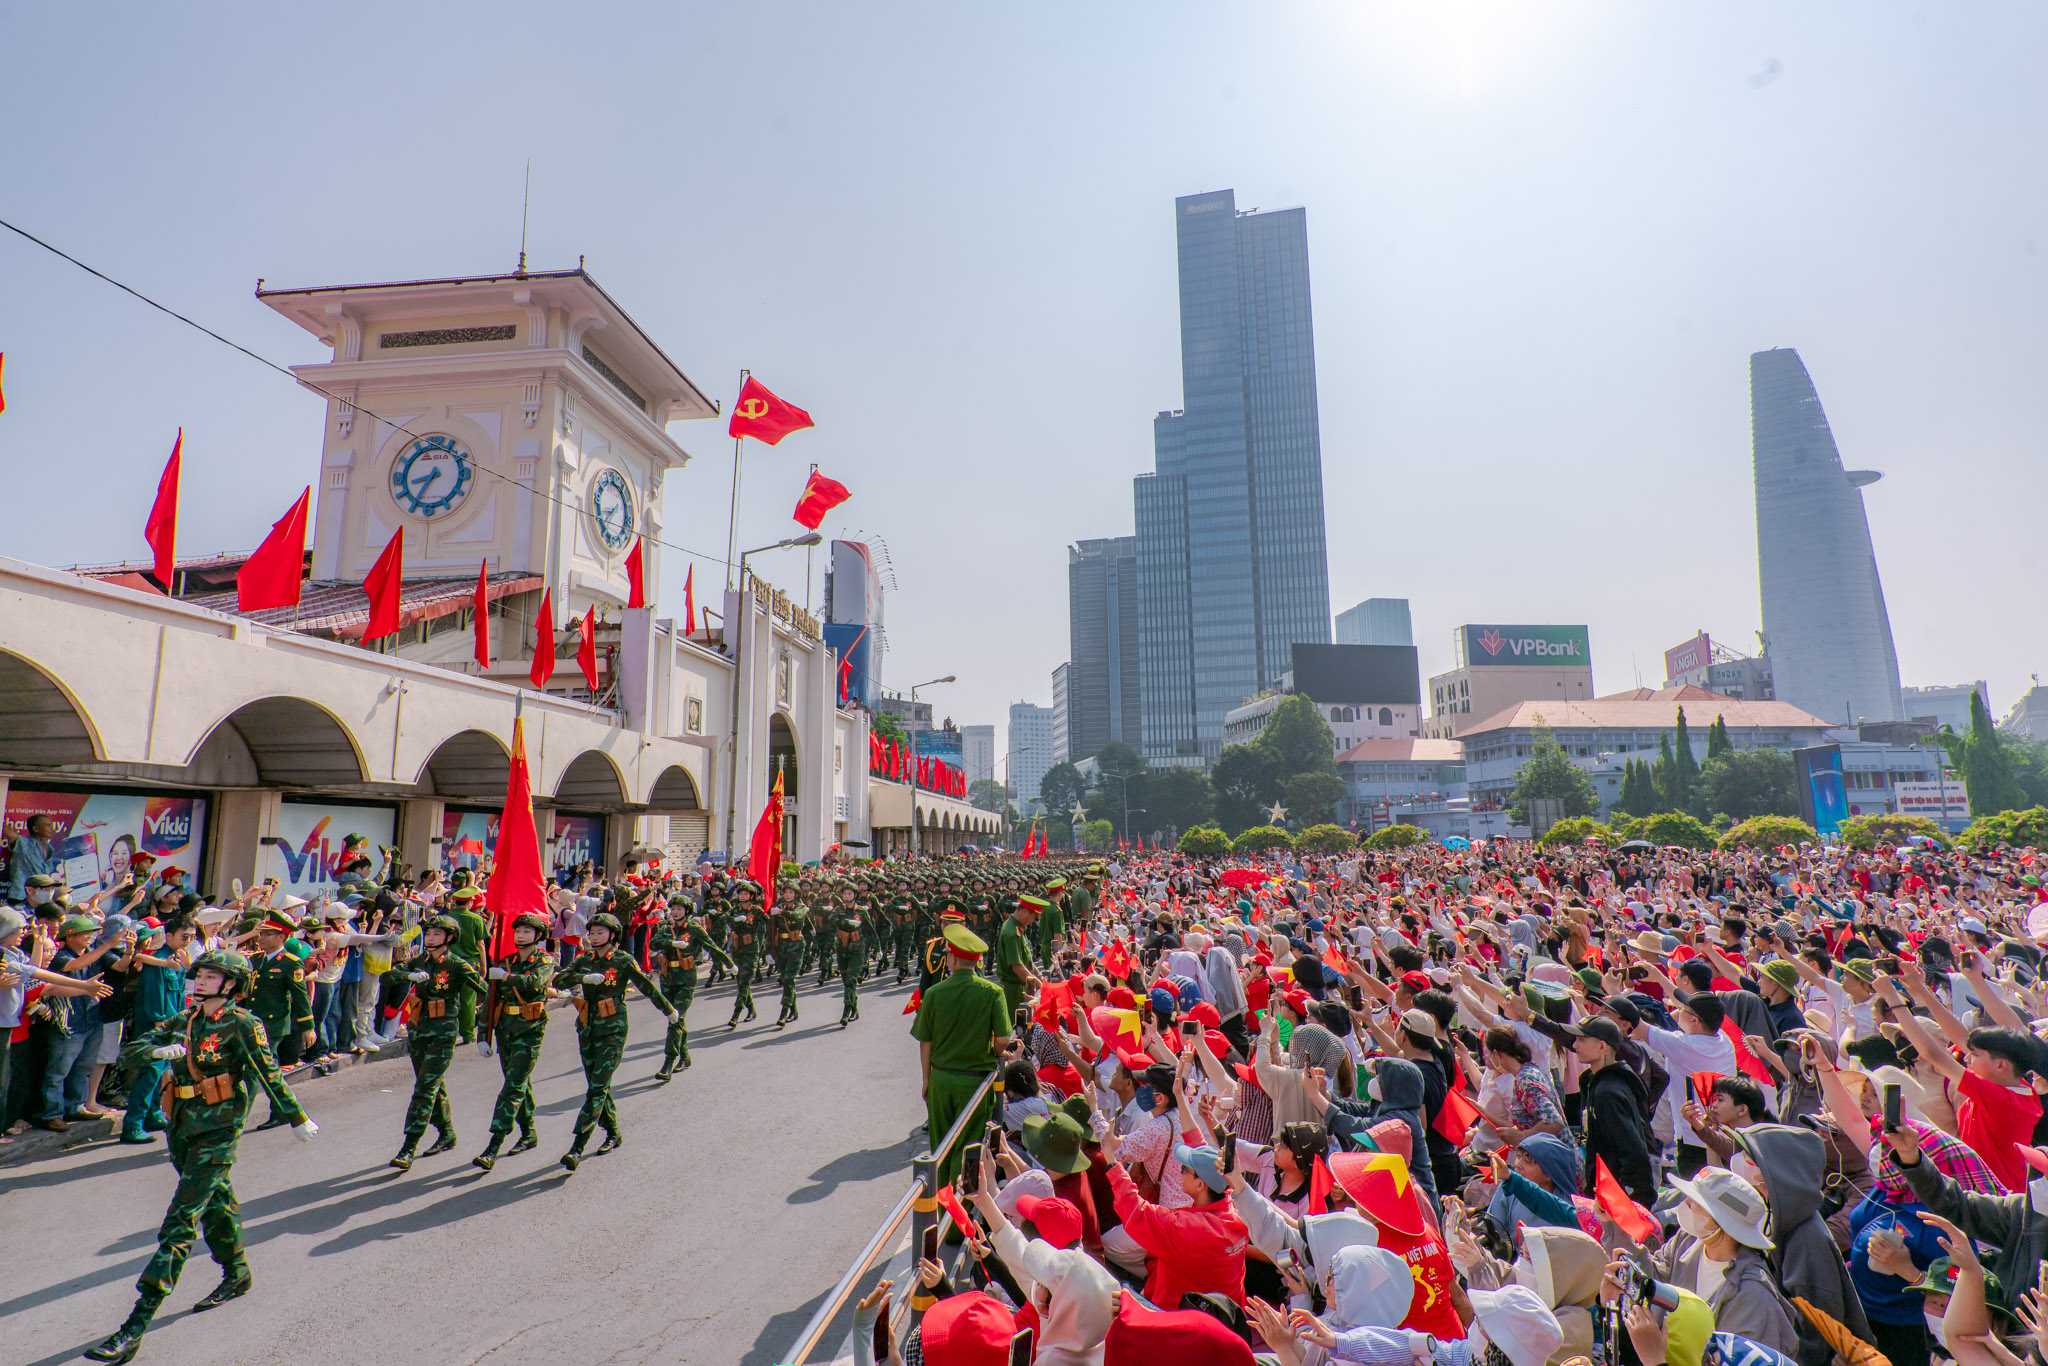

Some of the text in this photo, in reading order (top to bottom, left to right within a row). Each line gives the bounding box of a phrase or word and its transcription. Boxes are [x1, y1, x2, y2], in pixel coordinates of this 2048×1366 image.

[393, 472, 404, 485] 9
[460, 467, 471, 480] 3
[422, 503, 435, 516] 6
[772, 588, 791, 621] BẾN
[792, 604, 820, 640] THÀNH
[1508, 638, 1581, 656] VPBank
[145, 807, 190, 835] Vikki
[1406, 1242, 1439, 1263] VIỆT NAM
